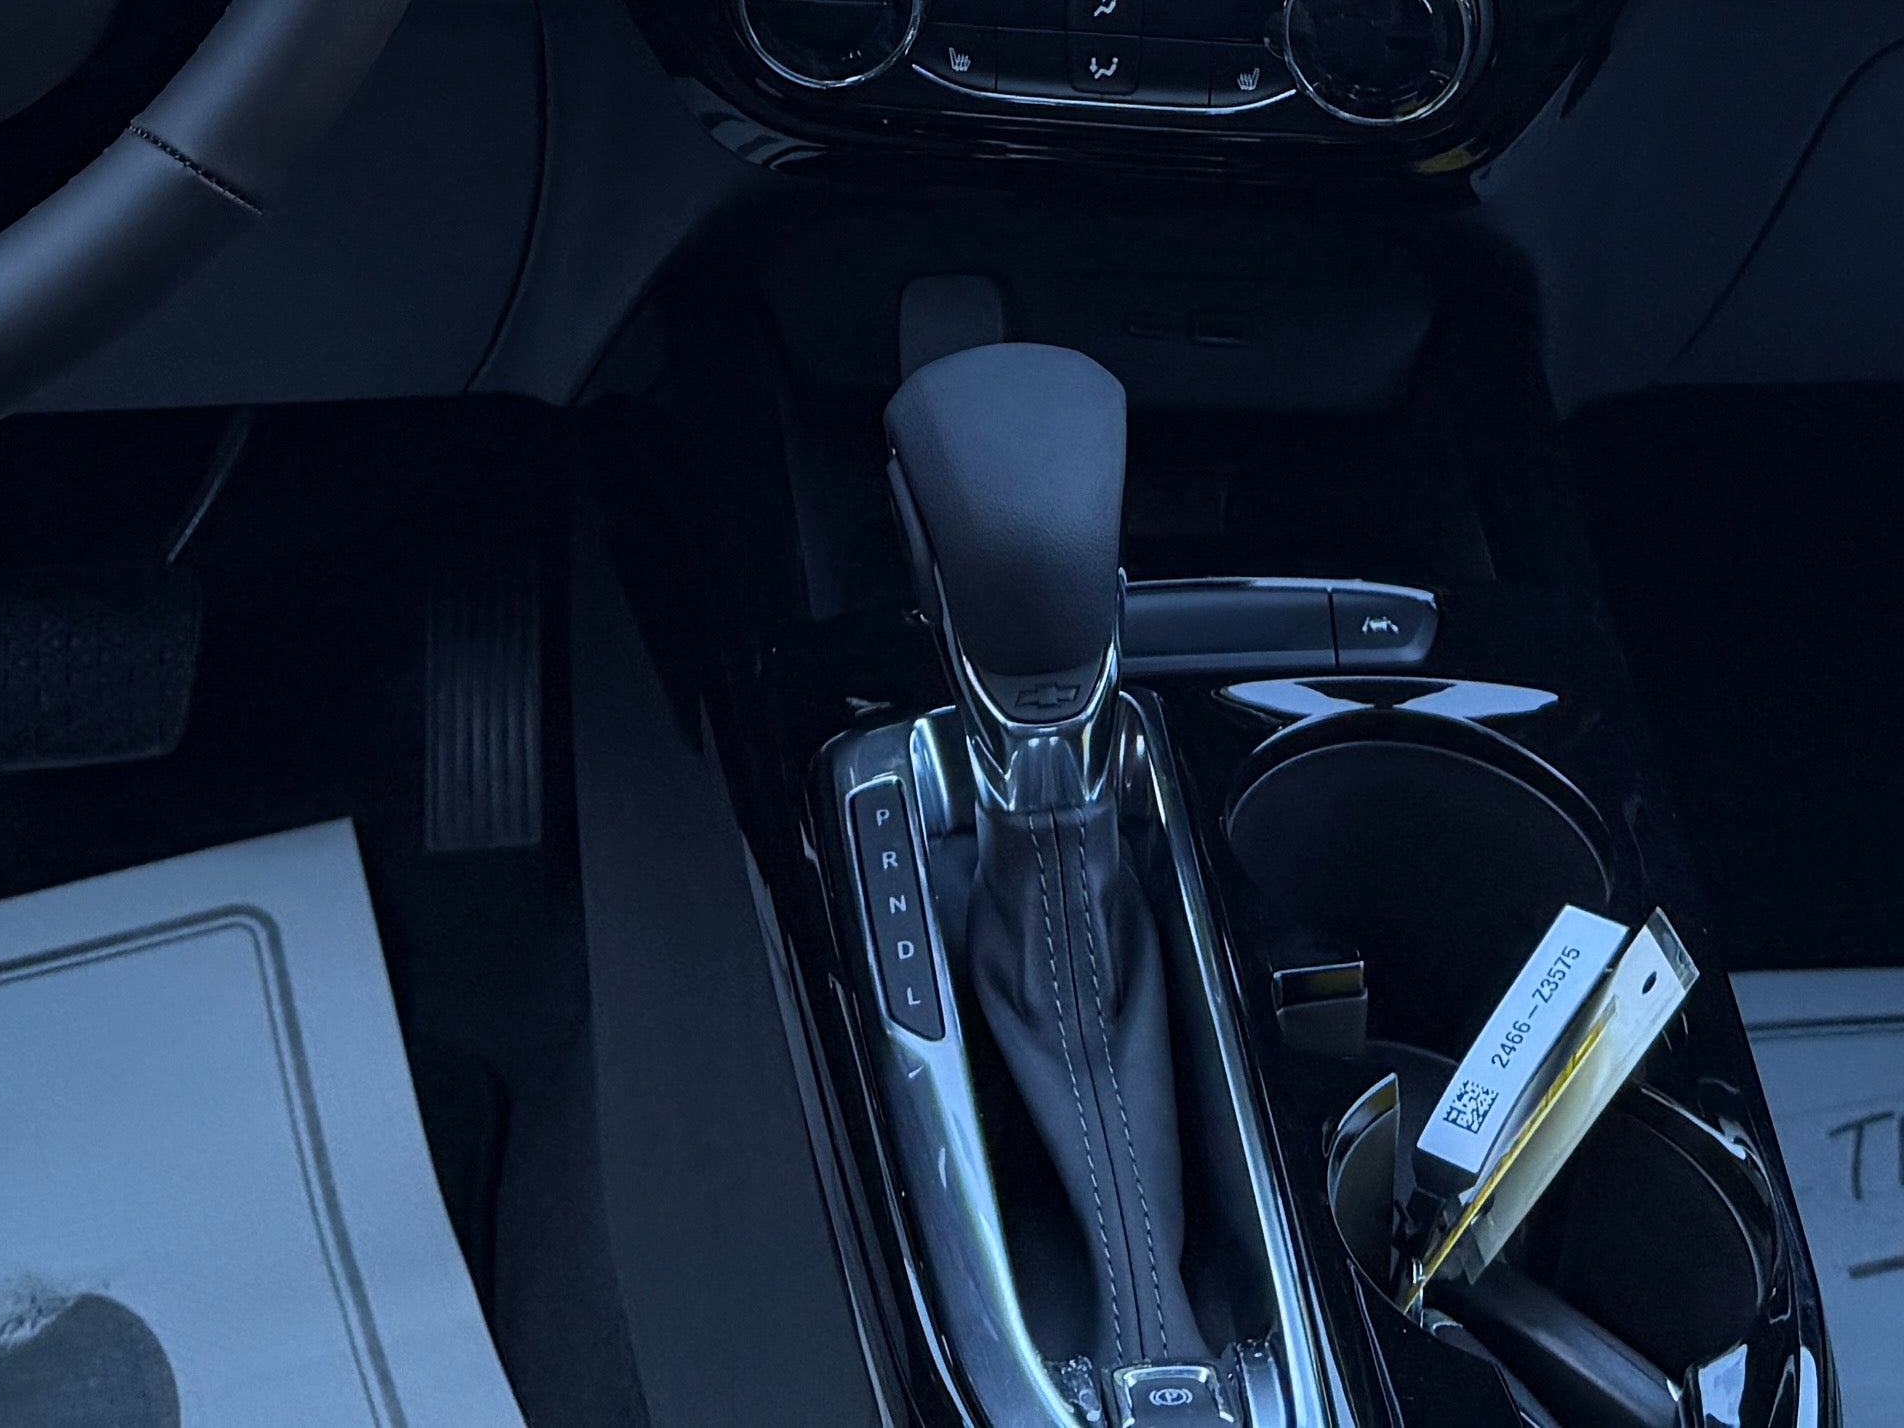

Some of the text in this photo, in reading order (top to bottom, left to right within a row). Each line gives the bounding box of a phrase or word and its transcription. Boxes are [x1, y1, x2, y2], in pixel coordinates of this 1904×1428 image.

[876, 809, 890, 827] P
[882, 851, 898, 872] R
[889, 895, 907, 914] N
[897, 941, 915, 960] D
[906, 987, 921, 1006] L
